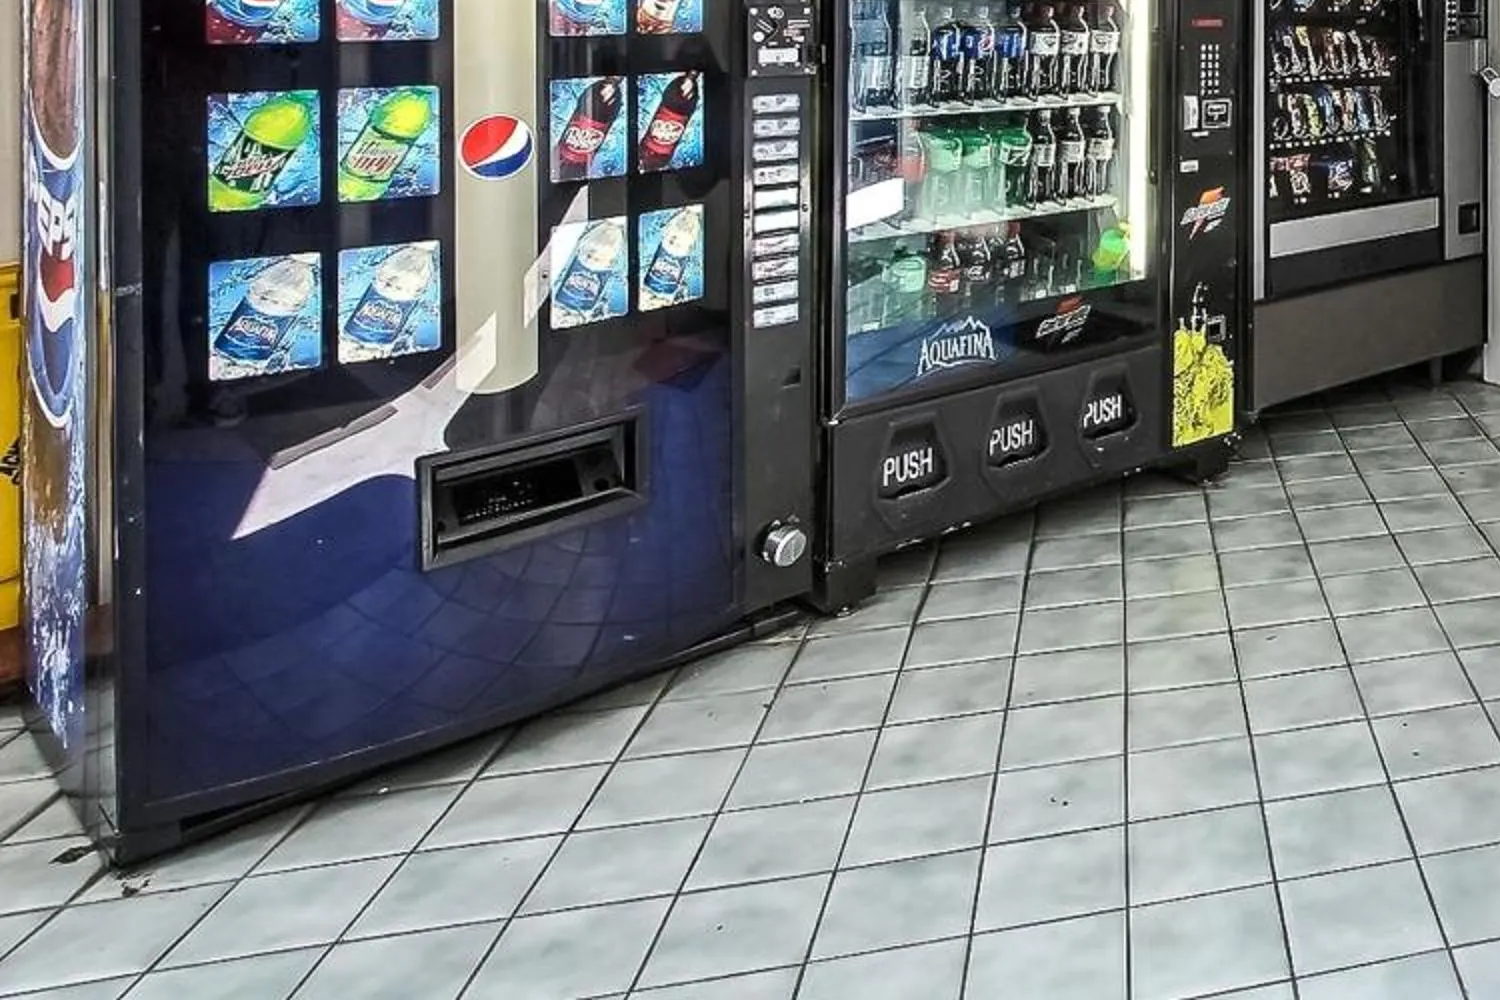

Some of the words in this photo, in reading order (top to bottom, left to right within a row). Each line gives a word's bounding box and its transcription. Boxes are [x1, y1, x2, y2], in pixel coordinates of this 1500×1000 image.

[917, 331, 998, 377] AQUAFINA
[1083, 394, 1123, 429] PUSH
[989, 419, 1034, 457] PUSH
[883, 447, 933, 487] PUSH
